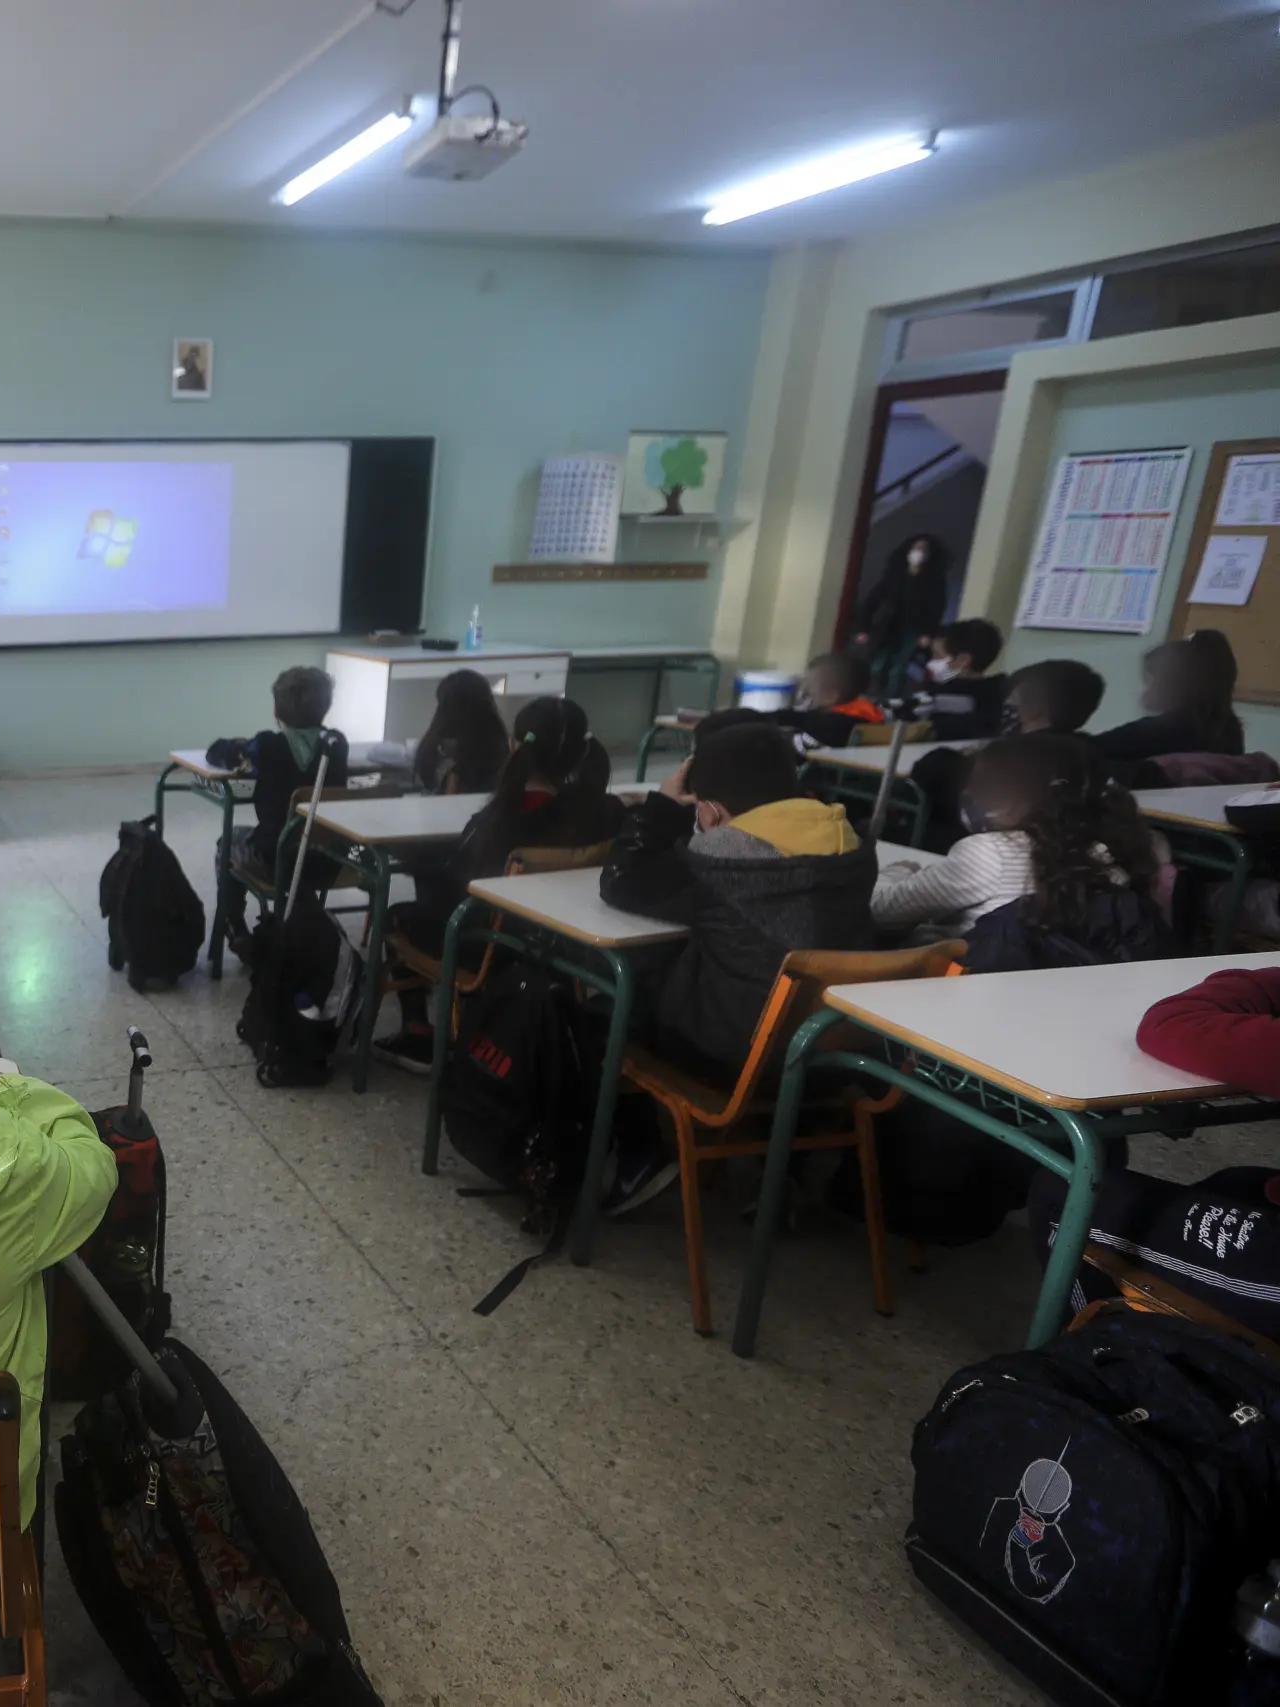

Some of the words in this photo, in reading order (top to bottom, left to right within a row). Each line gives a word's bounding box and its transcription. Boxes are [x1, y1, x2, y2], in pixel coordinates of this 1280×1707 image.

[1198, 1205, 1224, 1250] Please!!
[1222, 1214, 1238, 1226] the
[1233, 1219, 1254, 1250] Skating
[1216, 1226, 1233, 1258] House
